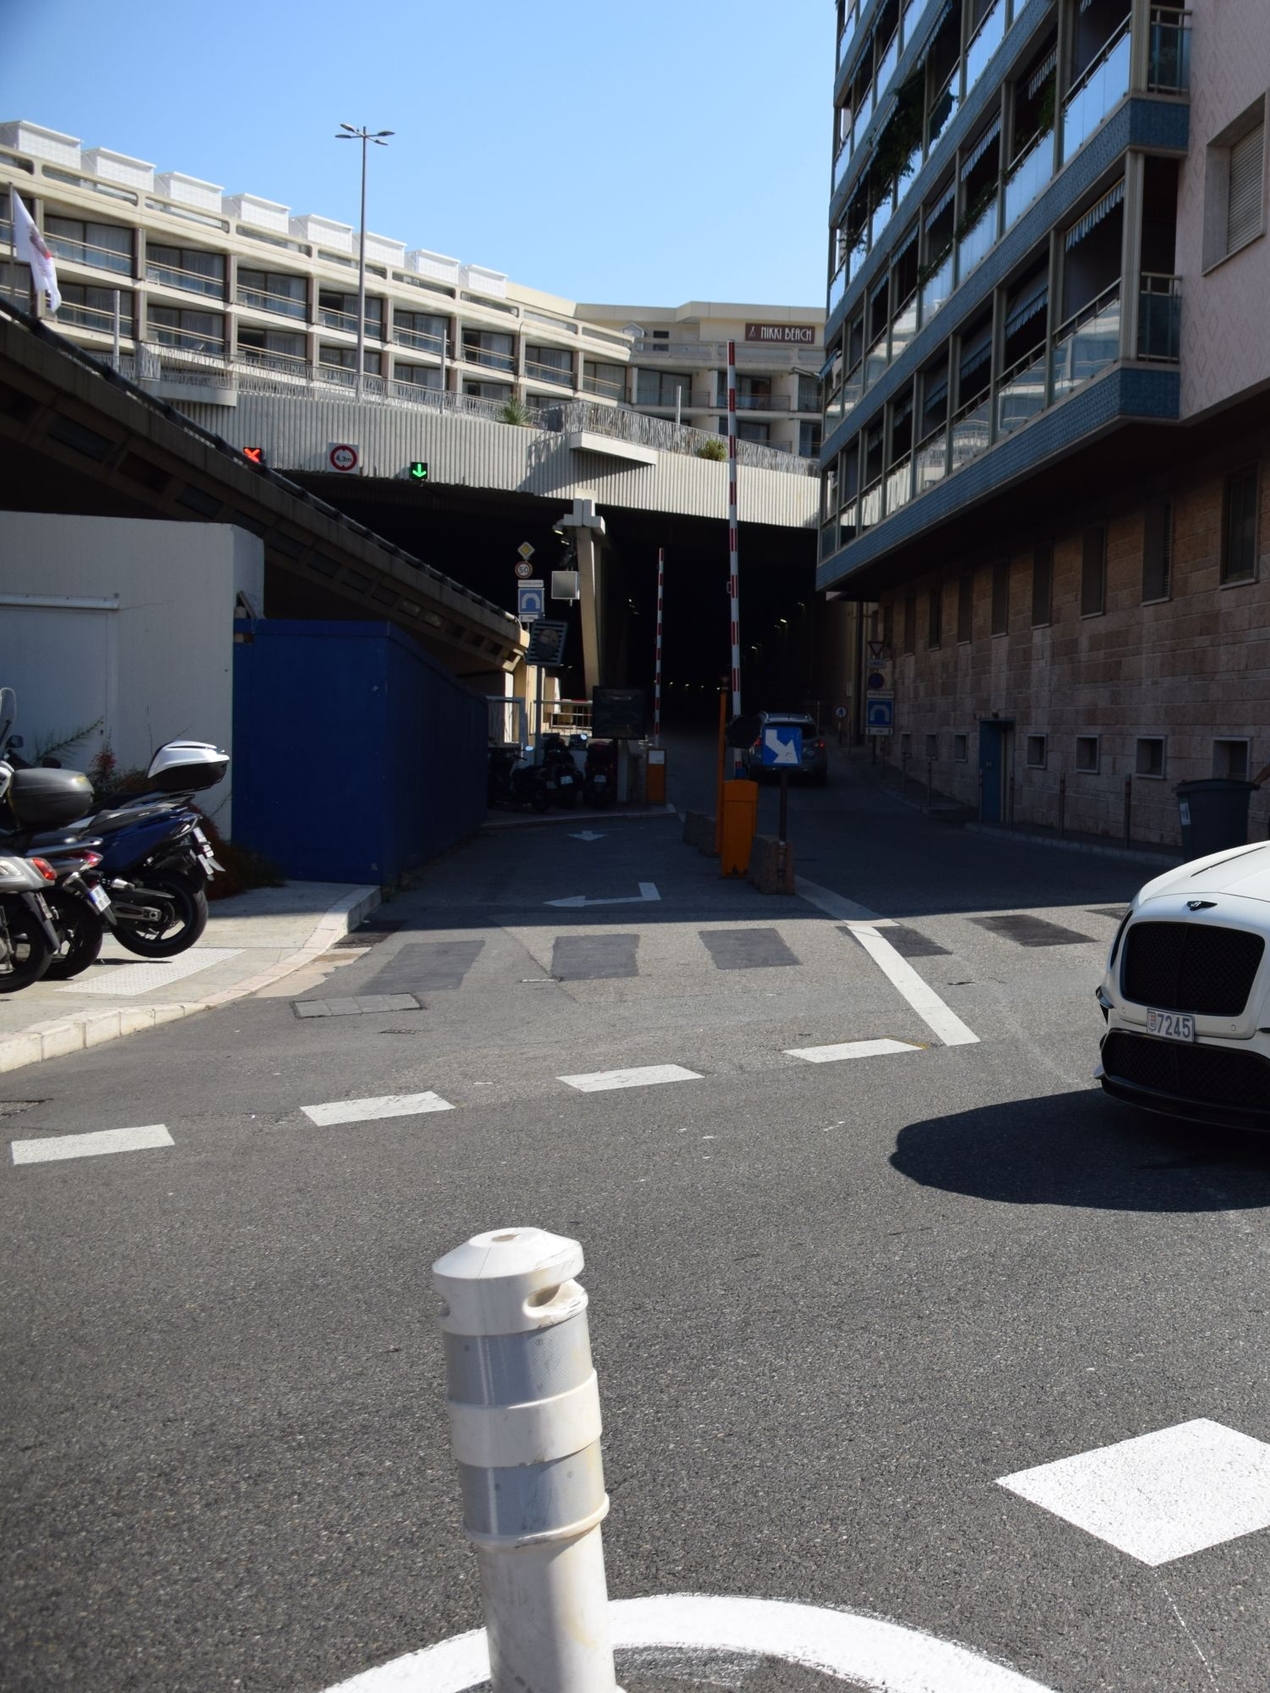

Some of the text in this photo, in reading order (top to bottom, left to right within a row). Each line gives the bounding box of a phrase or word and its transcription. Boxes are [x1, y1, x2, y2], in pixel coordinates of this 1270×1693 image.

[761, 326, 812, 342] NIKKI BEACH
[519, 566, 529, 574] 50
[1157, 1013, 1191, 1039] 7245
